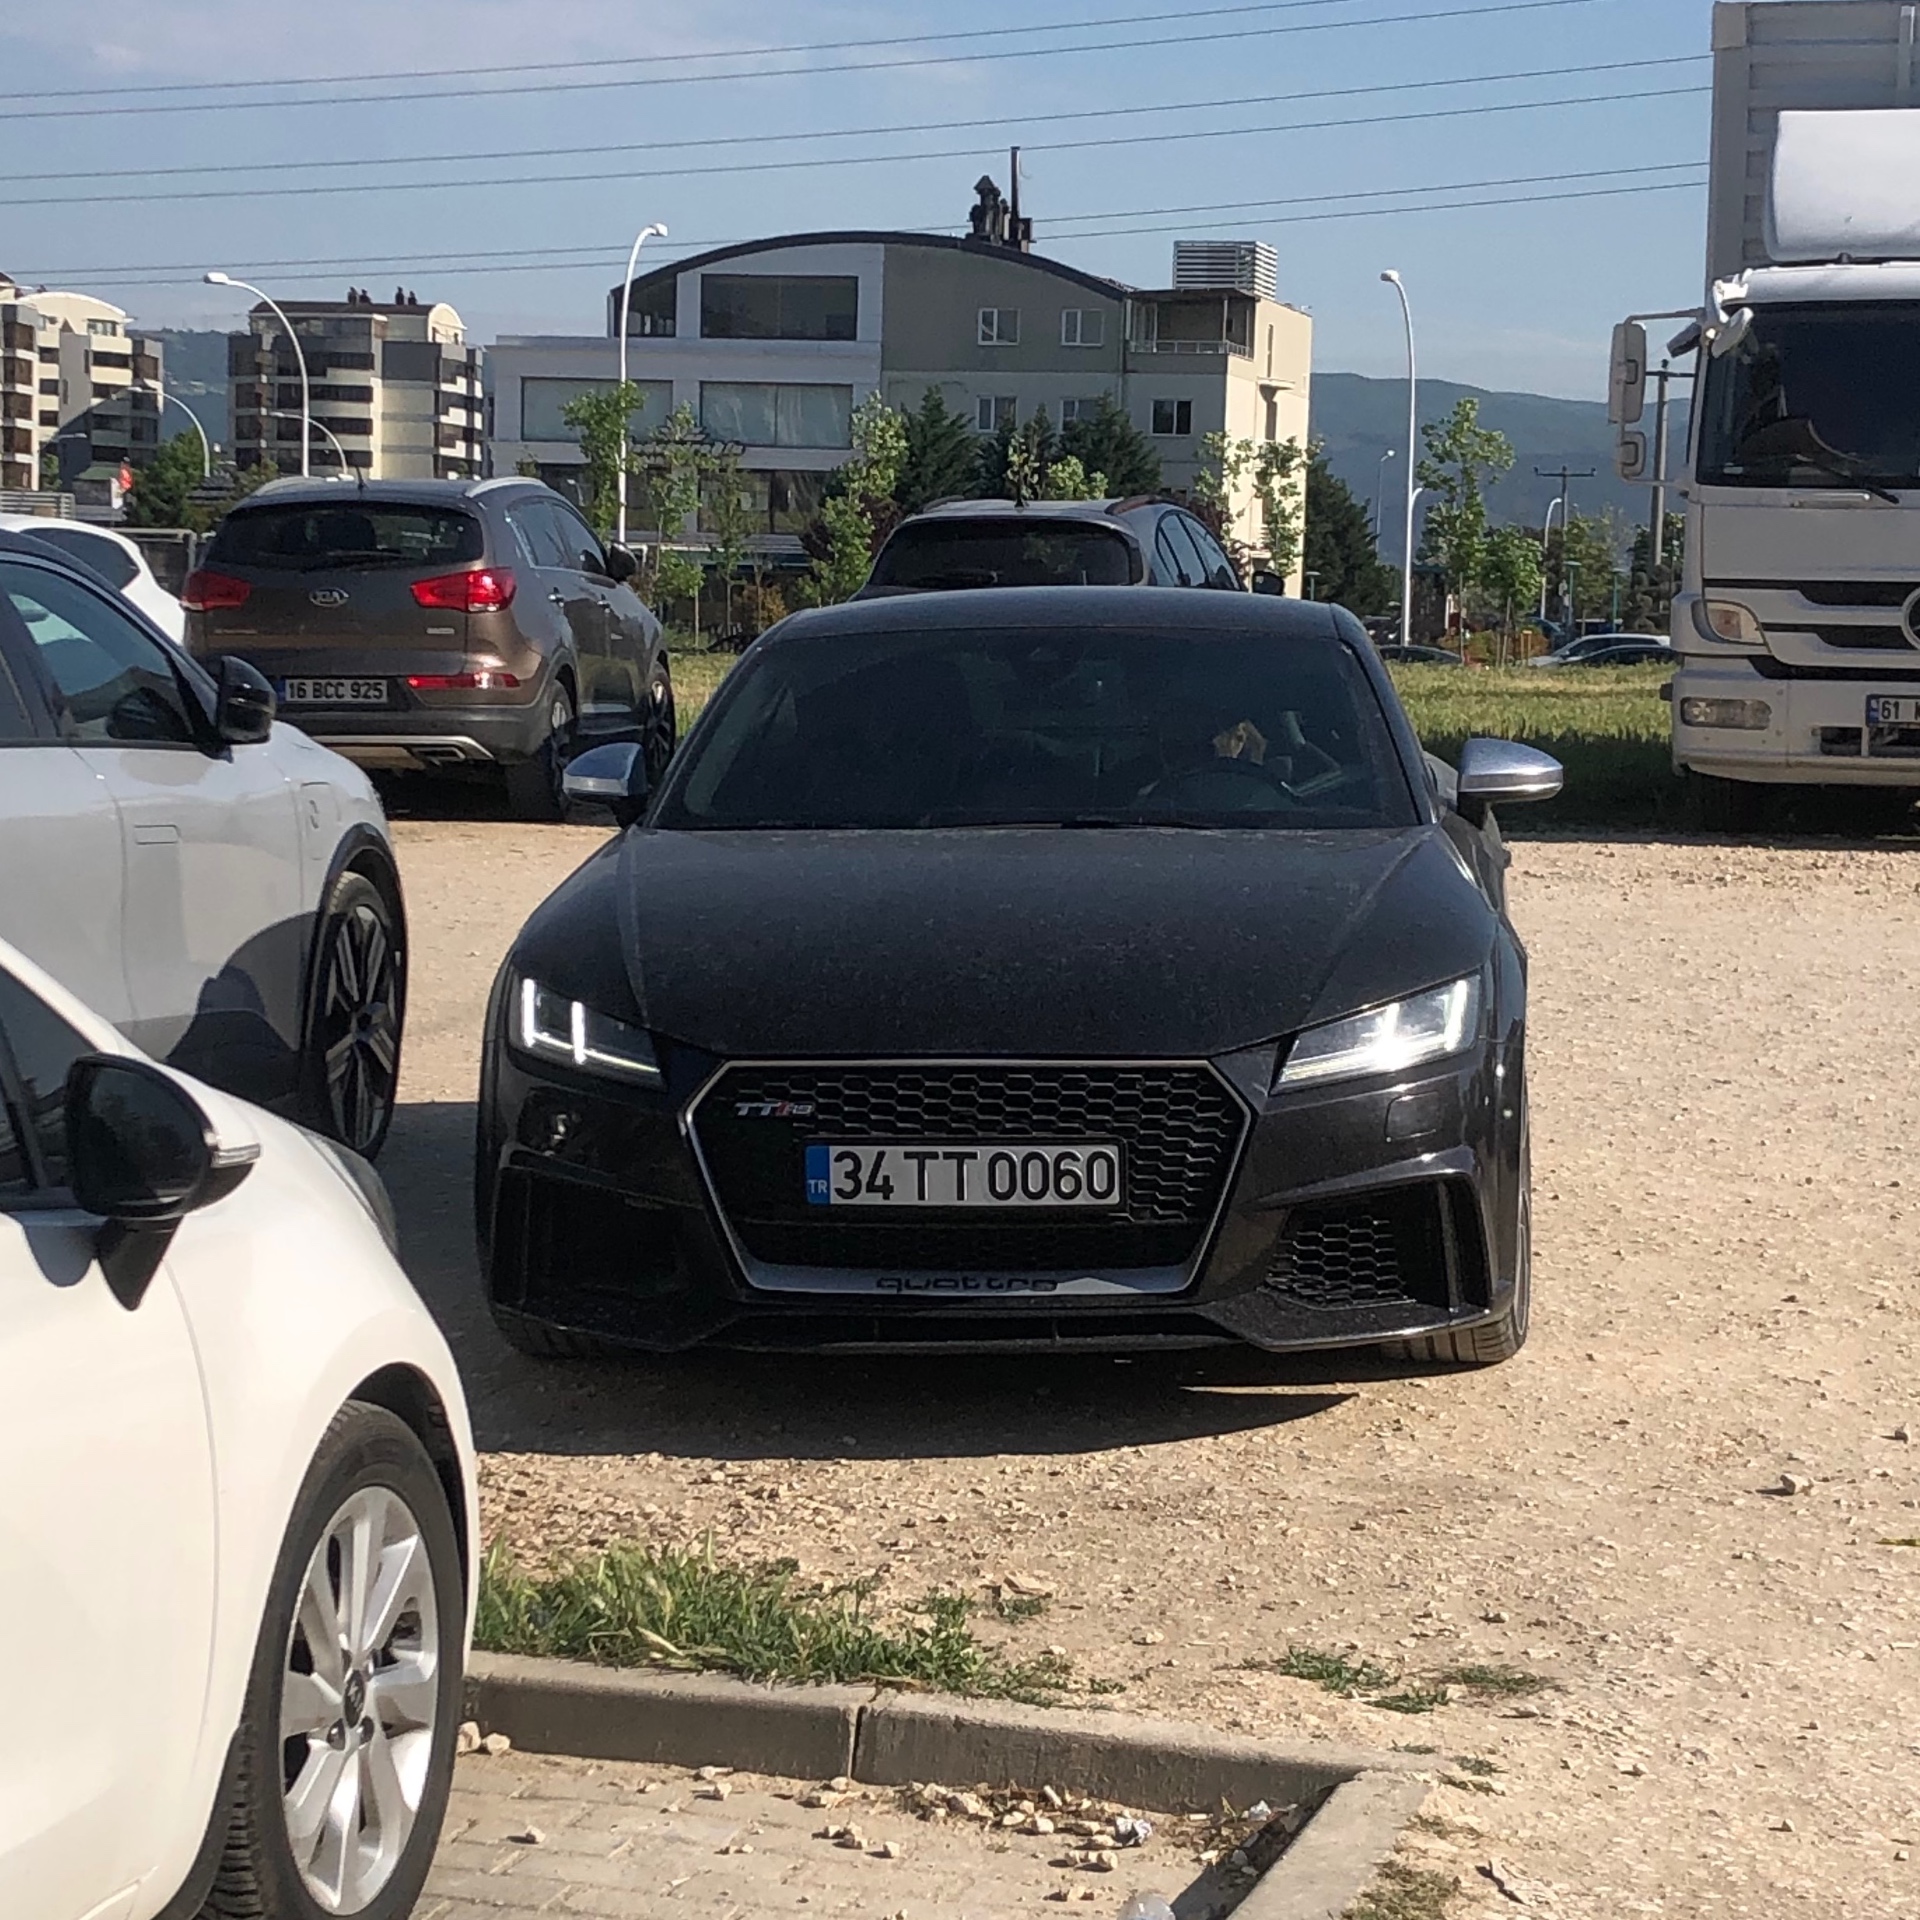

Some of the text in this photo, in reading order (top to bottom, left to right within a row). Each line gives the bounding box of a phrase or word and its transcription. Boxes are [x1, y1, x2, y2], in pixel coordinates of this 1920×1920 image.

[289, 682, 384, 699] 16 BCC 925
[1881, 700, 1900, 720] 61
[808, 1151, 1116, 1201] TR 34 TT 0060
[876, 1276, 1058, 1293] quattro
